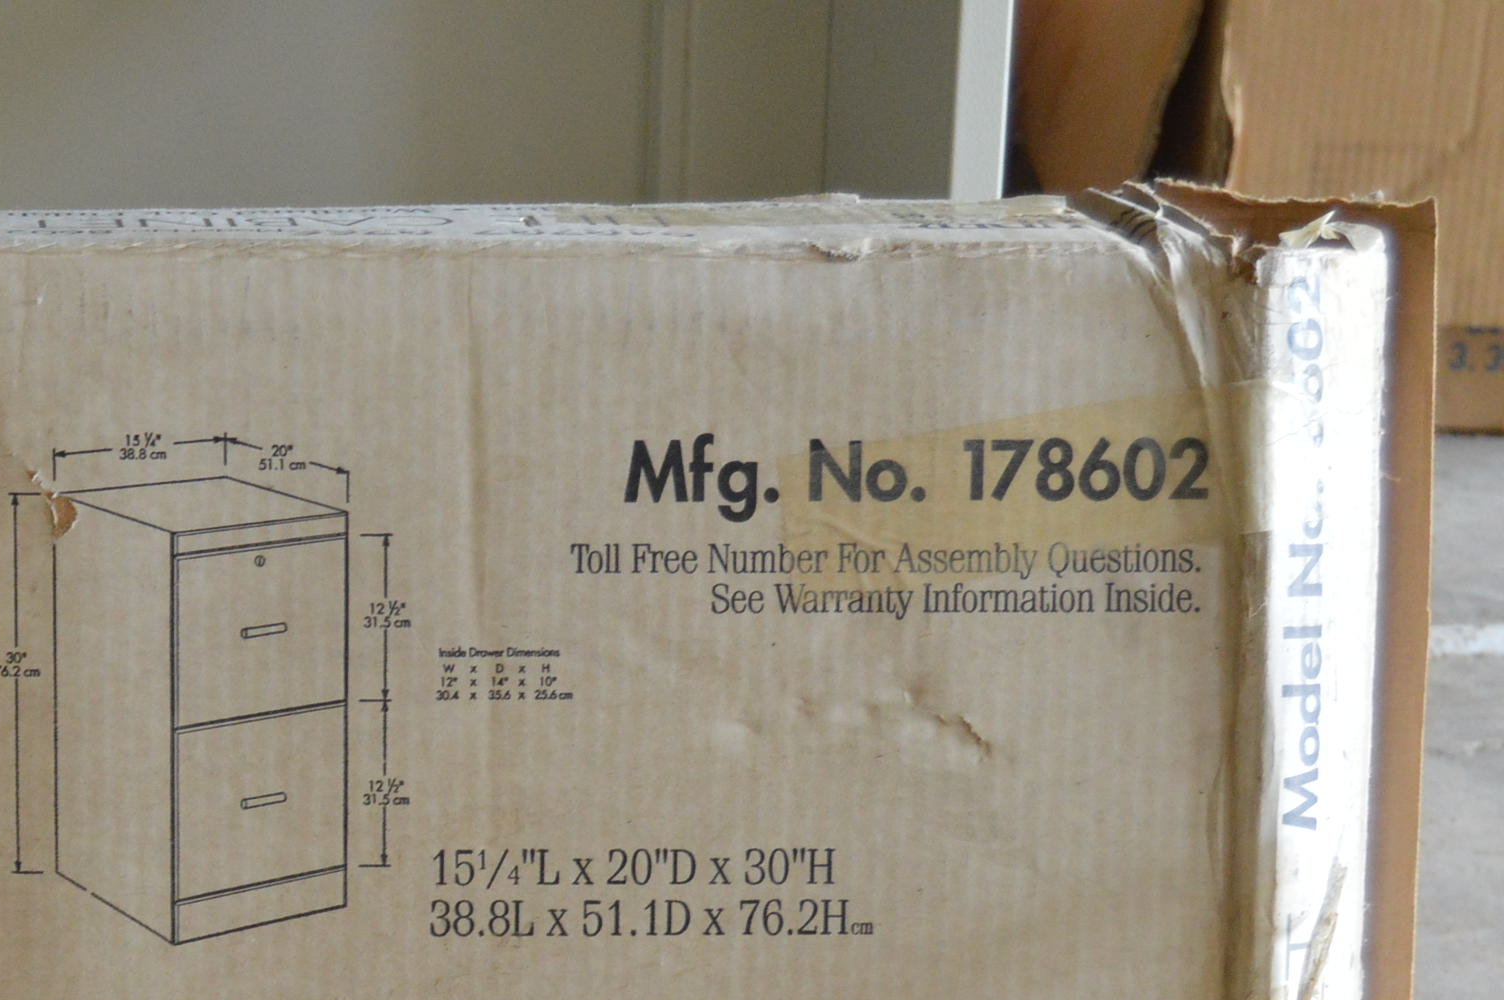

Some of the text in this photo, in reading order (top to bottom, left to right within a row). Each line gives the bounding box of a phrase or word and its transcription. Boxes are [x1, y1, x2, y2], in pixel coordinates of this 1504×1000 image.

[119, 448, 167, 460] 38.8 cm
[258, 458, 306, 471] 51.1 cm
[623, 432, 1210, 523] Mfg. No. 178602
[569, 541, 1202, 579] Toll Free Number For Assembly Questions.
[710, 581, 1201, 621] See Warranty Information Inside.
[363, 616, 411, 628] 31.5 cm
[438, 646, 561, 658] Inside Drawer Dimensions
[23, 668, 41, 677] cm
[1281, 626, 1323, 831] Model
[571, 857, 595, 886] x
[606, 847, 697, 886] 20"D
[708, 857, 732, 885] x
[744, 847, 836, 886] 30"H
[429, 898, 535, 938] 38.8L
[546, 908, 569, 937] x
[582, 898, 691, 938] 51.1D
[702, 907, 726, 936] x
